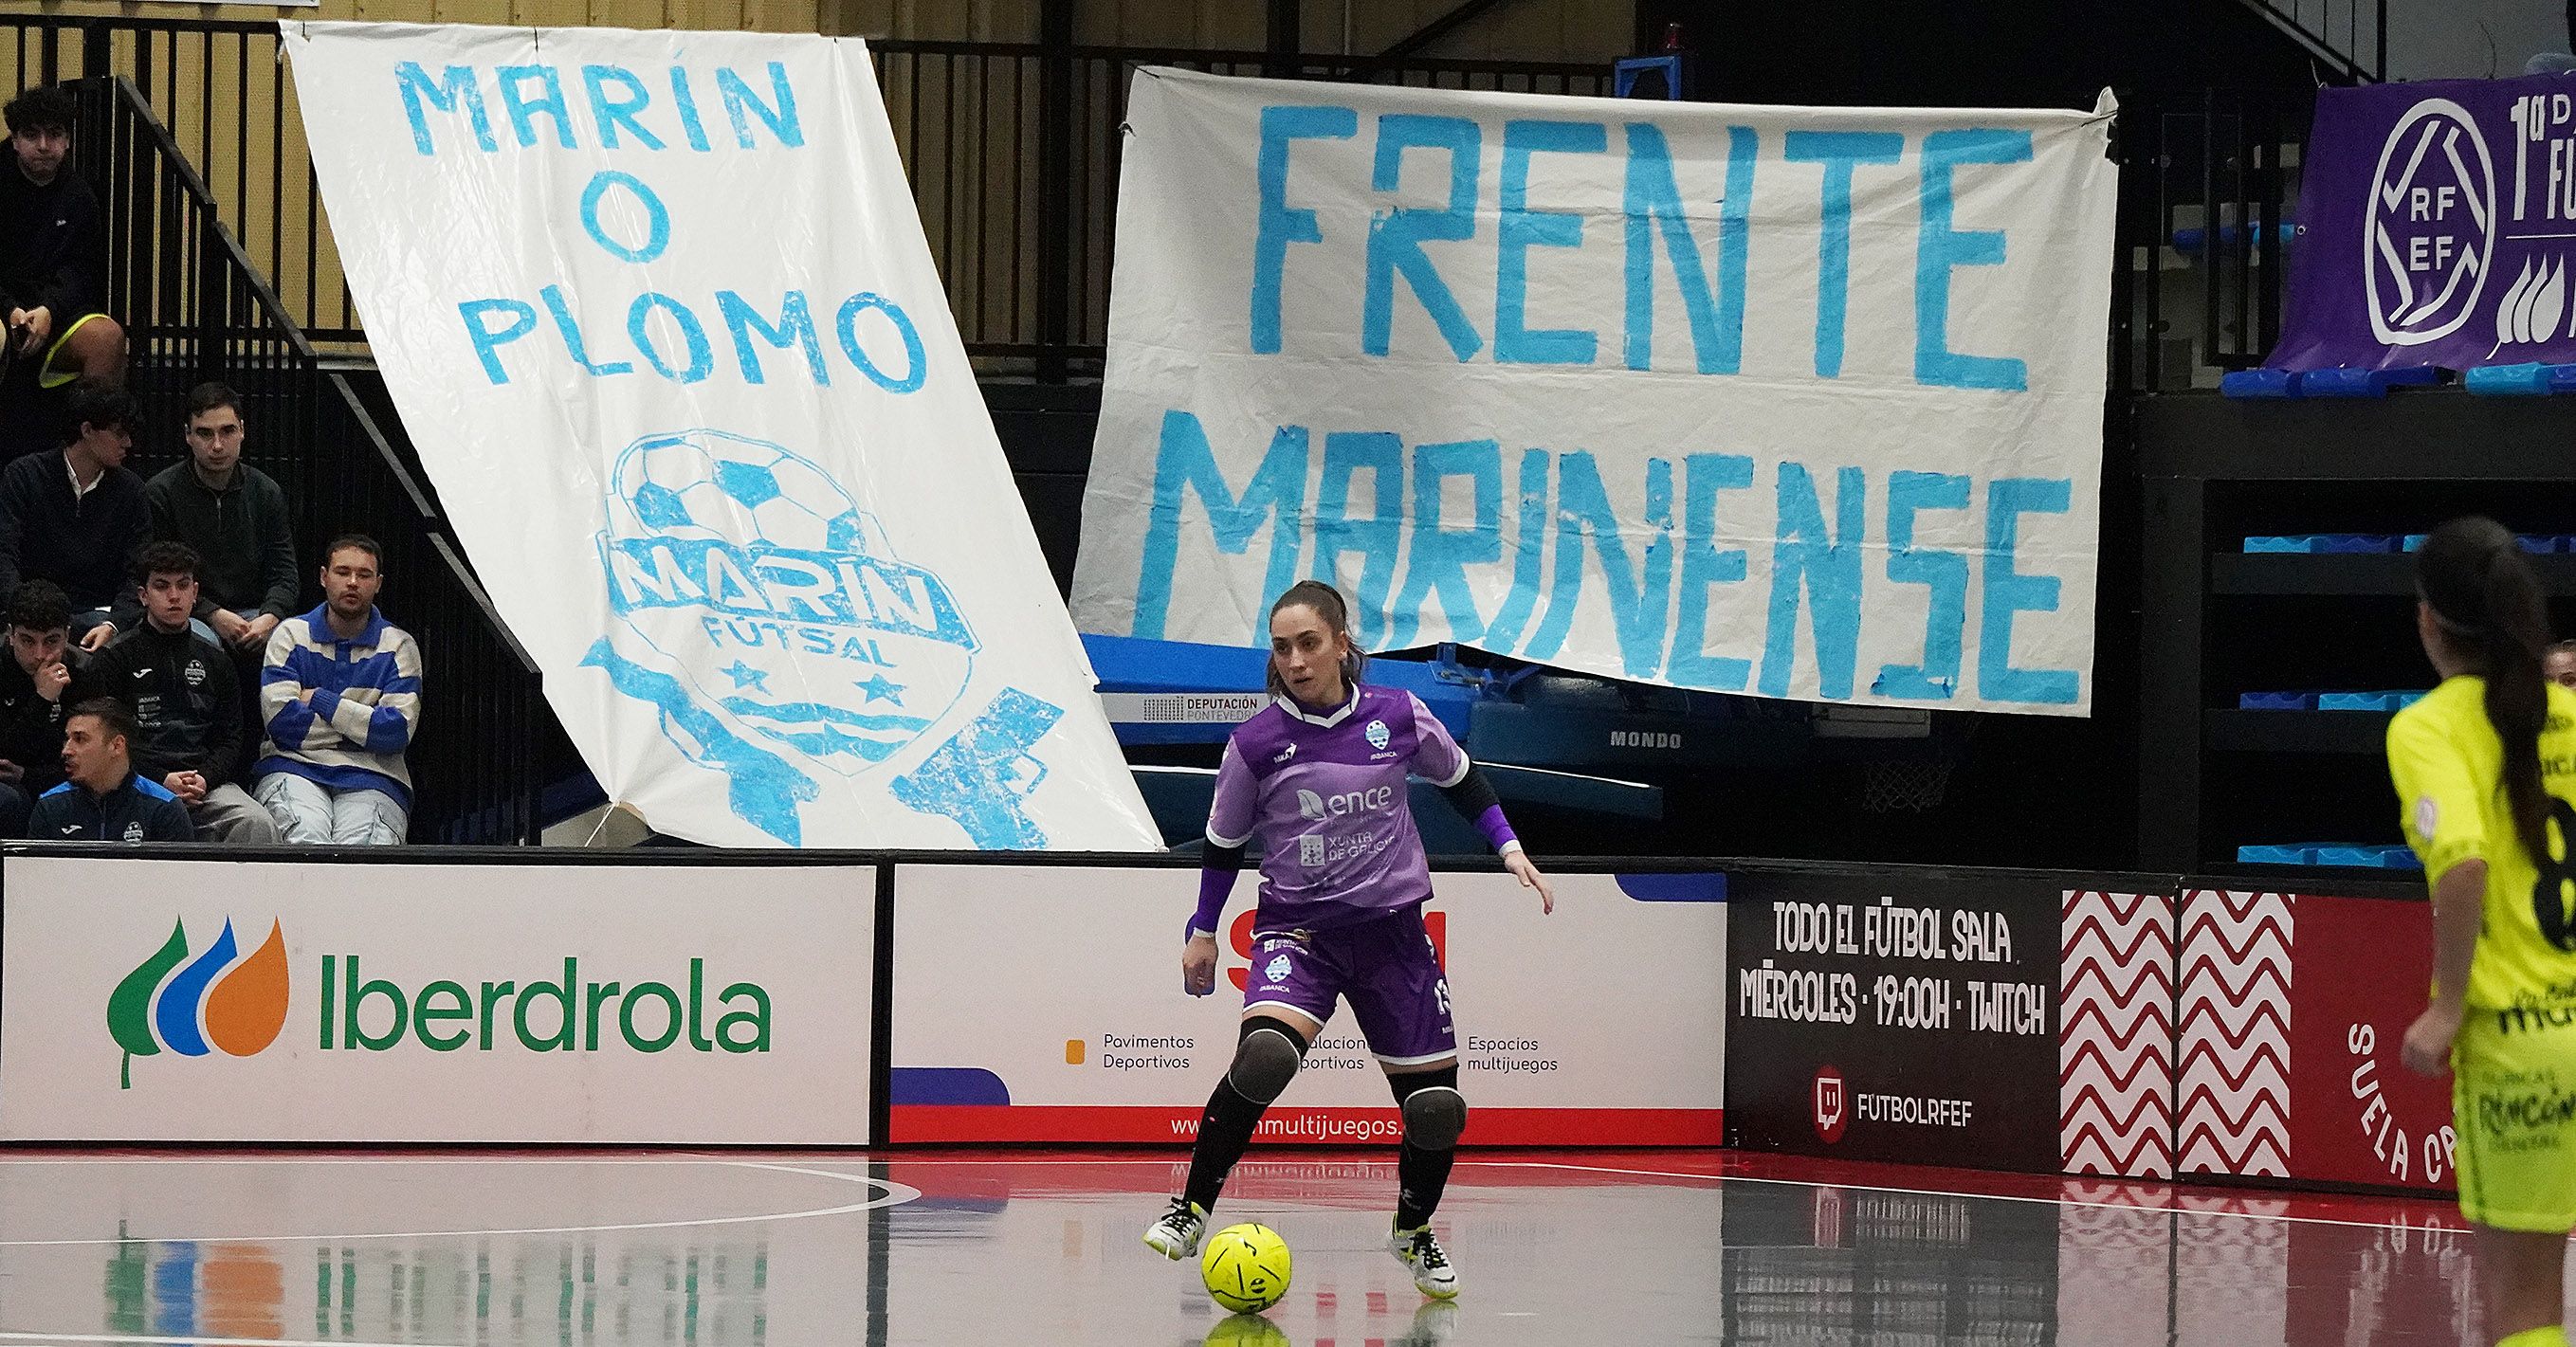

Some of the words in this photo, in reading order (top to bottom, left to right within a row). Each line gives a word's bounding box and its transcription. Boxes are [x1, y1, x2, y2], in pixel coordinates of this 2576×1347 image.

[580, 170, 671, 264] O
[2409, 186, 2457, 222] RF
[1251, 106, 2035, 391] FRENTE
[2409, 235, 2455, 271] EF
[457, 284, 927, 394] PLOMO
[1130, 410, 2080, 703] MARINENSE
[1187, 696, 1258, 709] DEPUTACIÓN
[1610, 731, 1682, 749] MONDO
[1328, 785, 1392, 815] ence
[1328, 831, 1373, 849] XUNTA
[1328, 848, 1346, 862] DE
[1773, 901, 1831, 955] TODO
[1836, 904, 1859, 955] EL
[1864, 896, 1946, 960] FÚTBOL
[1951, 909, 2012, 963] SALA
[320, 955, 772, 1053] Iberdrola
[1740, 958, 1857, 1025] MIÉRCOLES
[1873, 974, 1950, 1029] 19:00H
[1967, 980, 2046, 1036] TWITCH
[1104, 1033, 1195, 1048] Pavimentos
[1310, 1034, 1366, 1049] alacion
[1468, 1036, 1539, 1054] Espacios
[1104, 1053, 1190, 1072] Deportivos
[1300, 1055, 1364, 1073] portivas
[1467, 1056, 1559, 1075] multijuegos
[2348, 1023, 2408, 1182] SUELA
